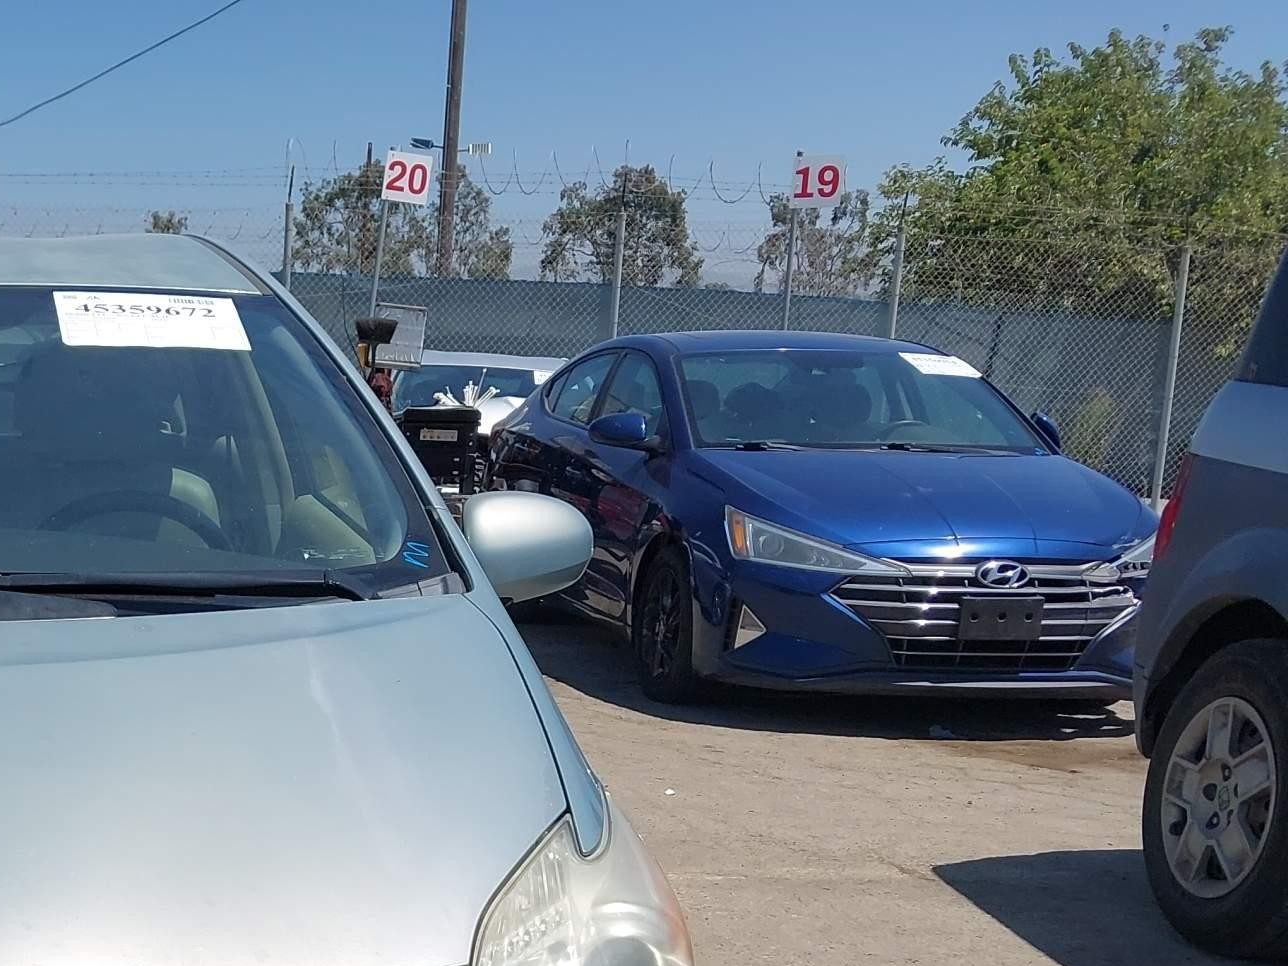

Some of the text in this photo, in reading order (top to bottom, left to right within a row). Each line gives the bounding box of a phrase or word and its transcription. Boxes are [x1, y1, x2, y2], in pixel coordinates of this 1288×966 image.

[386, 160, 428, 194] 20
[794, 165, 840, 198] 19
[76, 303, 215, 318] 45359672
